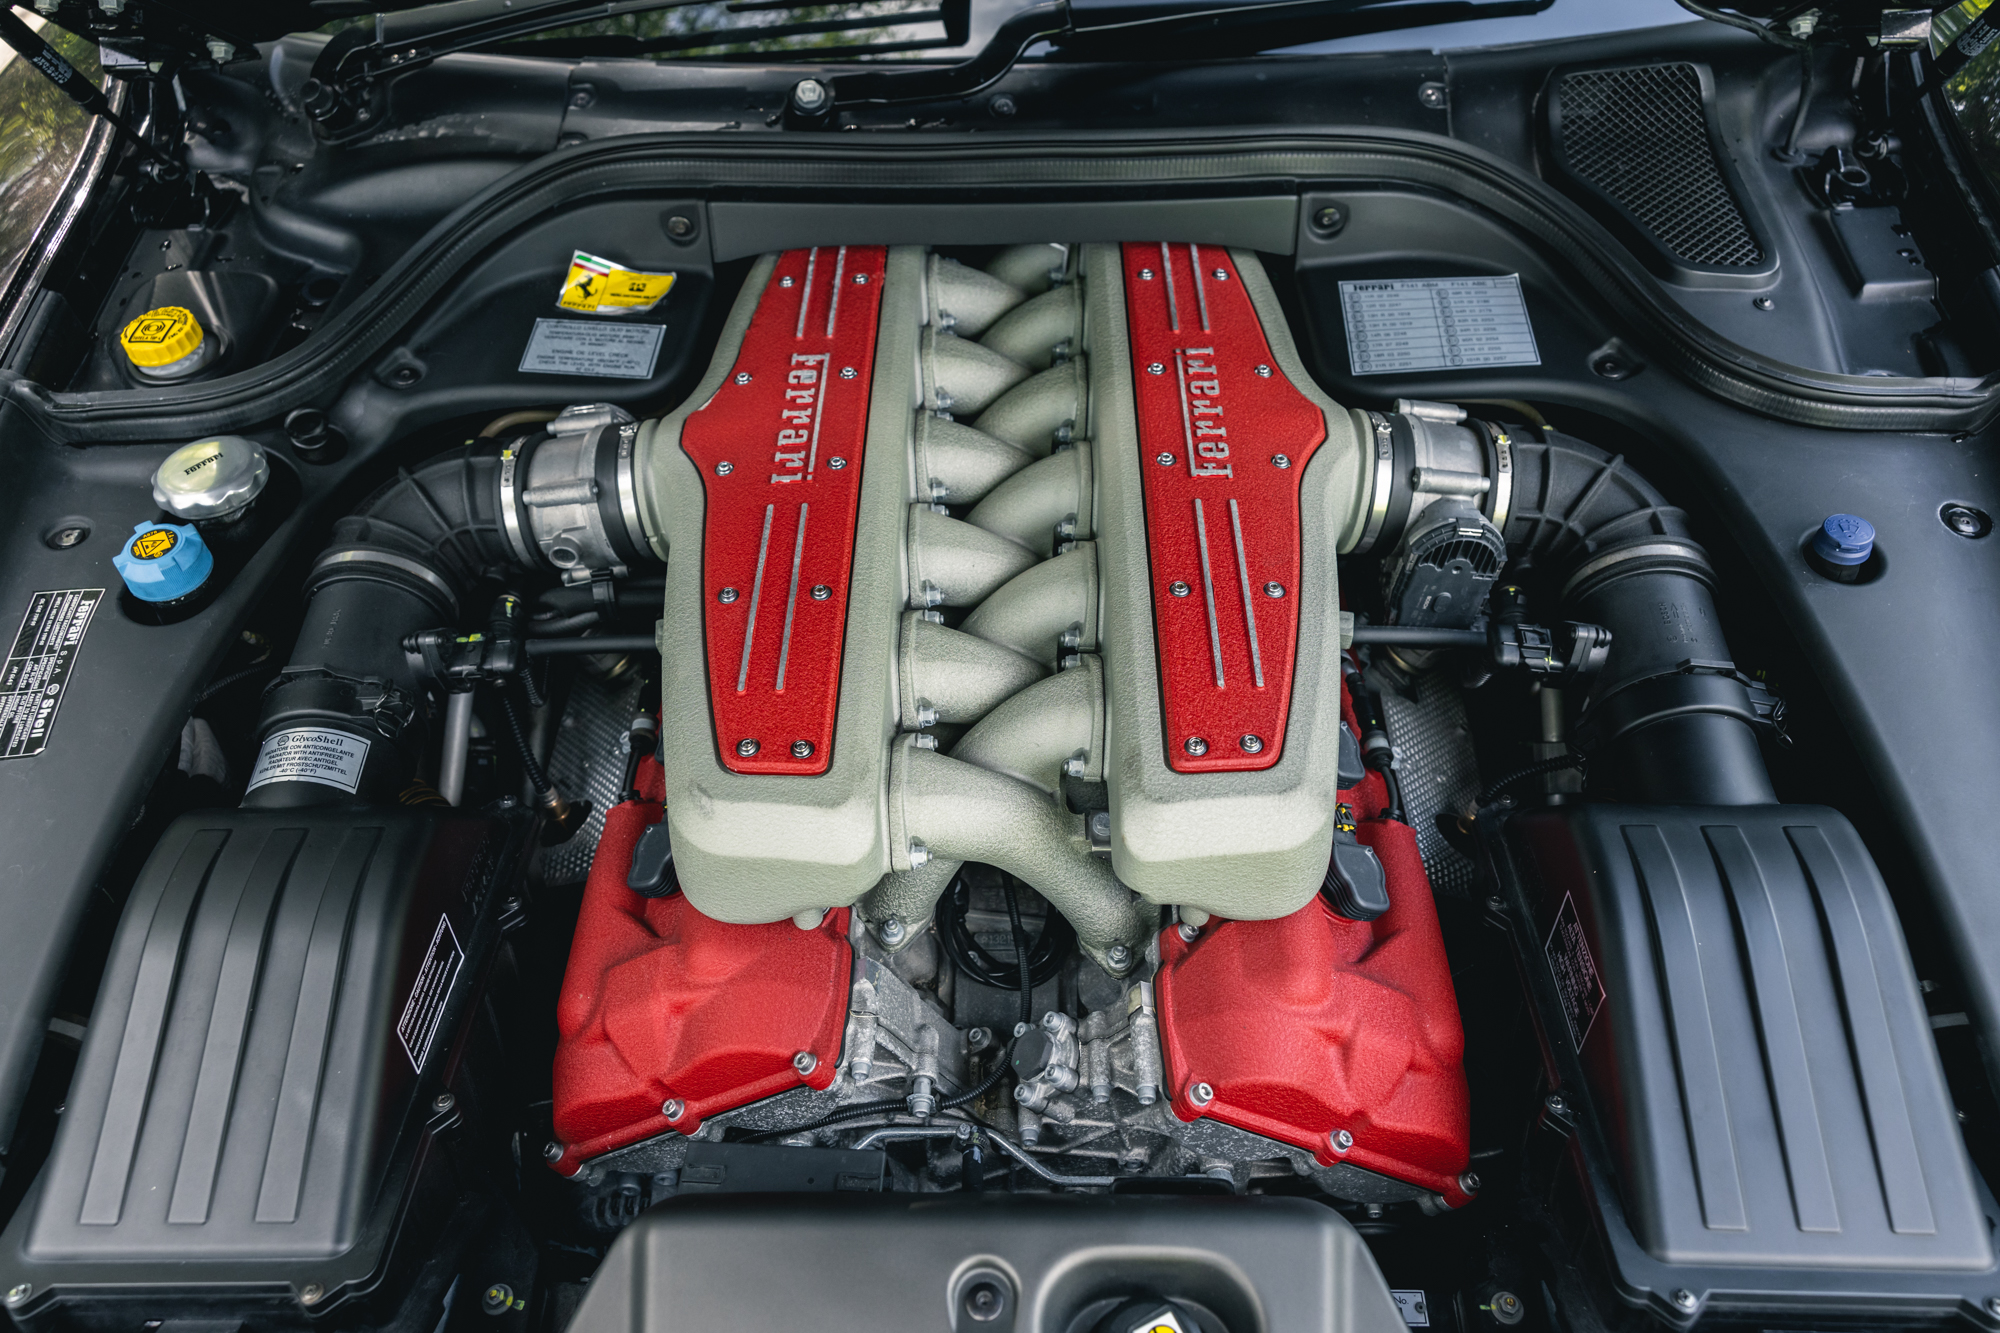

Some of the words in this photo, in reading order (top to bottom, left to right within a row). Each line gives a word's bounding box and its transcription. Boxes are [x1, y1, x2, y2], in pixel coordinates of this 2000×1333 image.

[1353, 283, 1394, 292] Ferrari
[770, 353, 830, 485] Ferrari
[1175, 346, 1234, 480] Ferrari
[183, 452, 224, 476] Ferrari
[65, 600, 94, 645] Ferrari
[27, 694, 35, 707] PARTS
[12, 721, 24, 747] LUBRICATED
[31, 699, 54, 737] Shell
[265, 746, 288, 756] RADIATORE
[302, 745, 355, 758] ANTICONGELANTE
[268, 751, 292, 760] RADIATOR
[308, 750, 343, 761] ANTIFREEZE
[292, 734, 344, 746] GlycoShell
[268, 757, 296, 765] RADIATEUR
[312, 757, 338, 766] ANTIGEL
[286, 761, 348, 775] FROSTSCHUTZMITTEL
[1574, 923, 1593, 977] ATTENZIONE
[1564, 954, 1578, 995] WARNING
[1576, 945, 1591, 991] TENSIONE
[402, 1000, 415, 1032] ATTENZIONE
[415, 975, 425, 997] CAUTION
[425, 946, 436, 973] ATTENTION
[1566, 976, 1579, 1017] VOLTAGE
